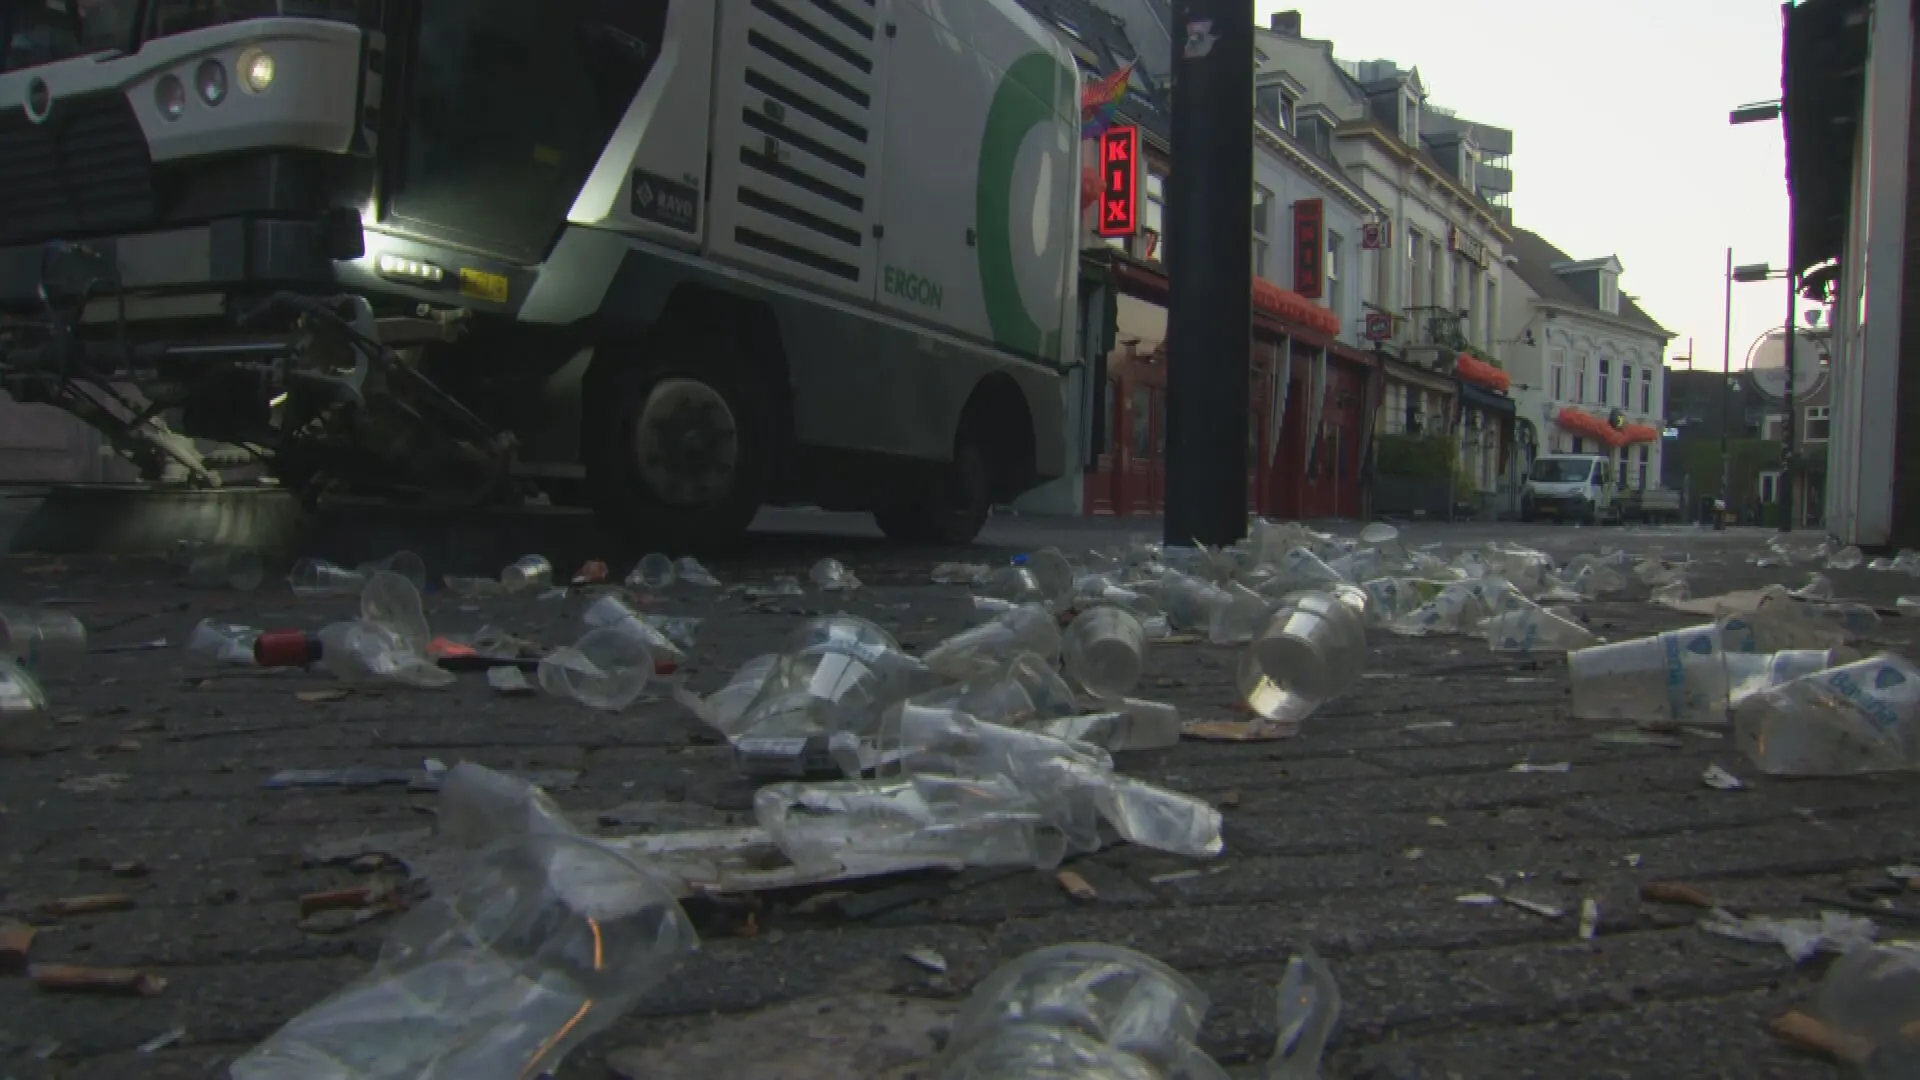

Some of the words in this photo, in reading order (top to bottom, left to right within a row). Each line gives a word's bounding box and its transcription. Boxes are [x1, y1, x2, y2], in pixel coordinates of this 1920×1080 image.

[656, 189, 693, 218] RAVO
[1107, 139, 1128, 221] KIX
[884, 264, 943, 311] ERGON
